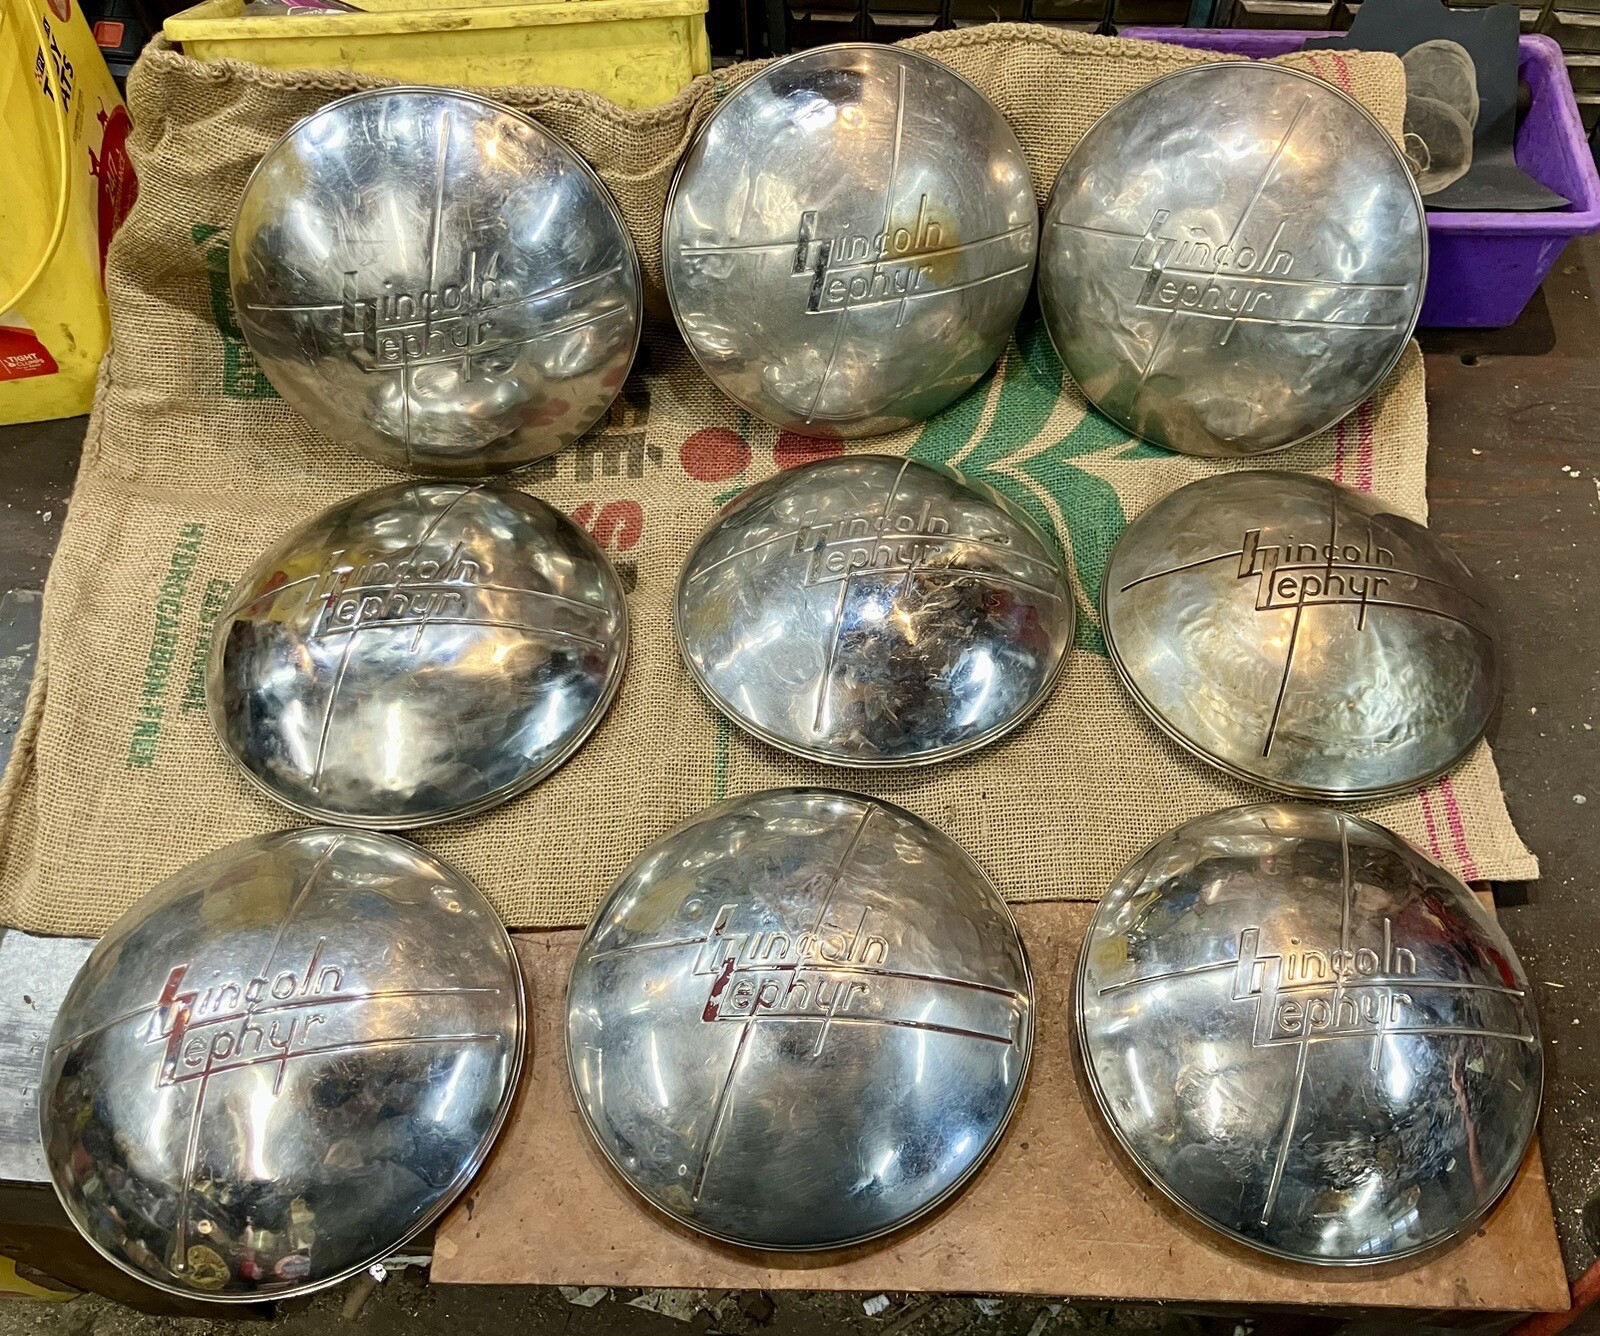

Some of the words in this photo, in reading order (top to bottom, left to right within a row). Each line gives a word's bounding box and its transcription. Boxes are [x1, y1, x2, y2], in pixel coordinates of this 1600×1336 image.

[789, 194, 943, 277] Lincoln
[1130, 209, 1295, 275] Lincoln
[6, 352, 39, 363] TIGHT
[790, 501, 950, 557] Lincoln
[1237, 528, 1394, 578] Lincoln
[306, 541, 480, 604] Lincoln
[692, 903, 889, 975] Lincoln
[1231, 918, 1416, 1001] Lincoln
[143, 937, 344, 1044] Lincoln
